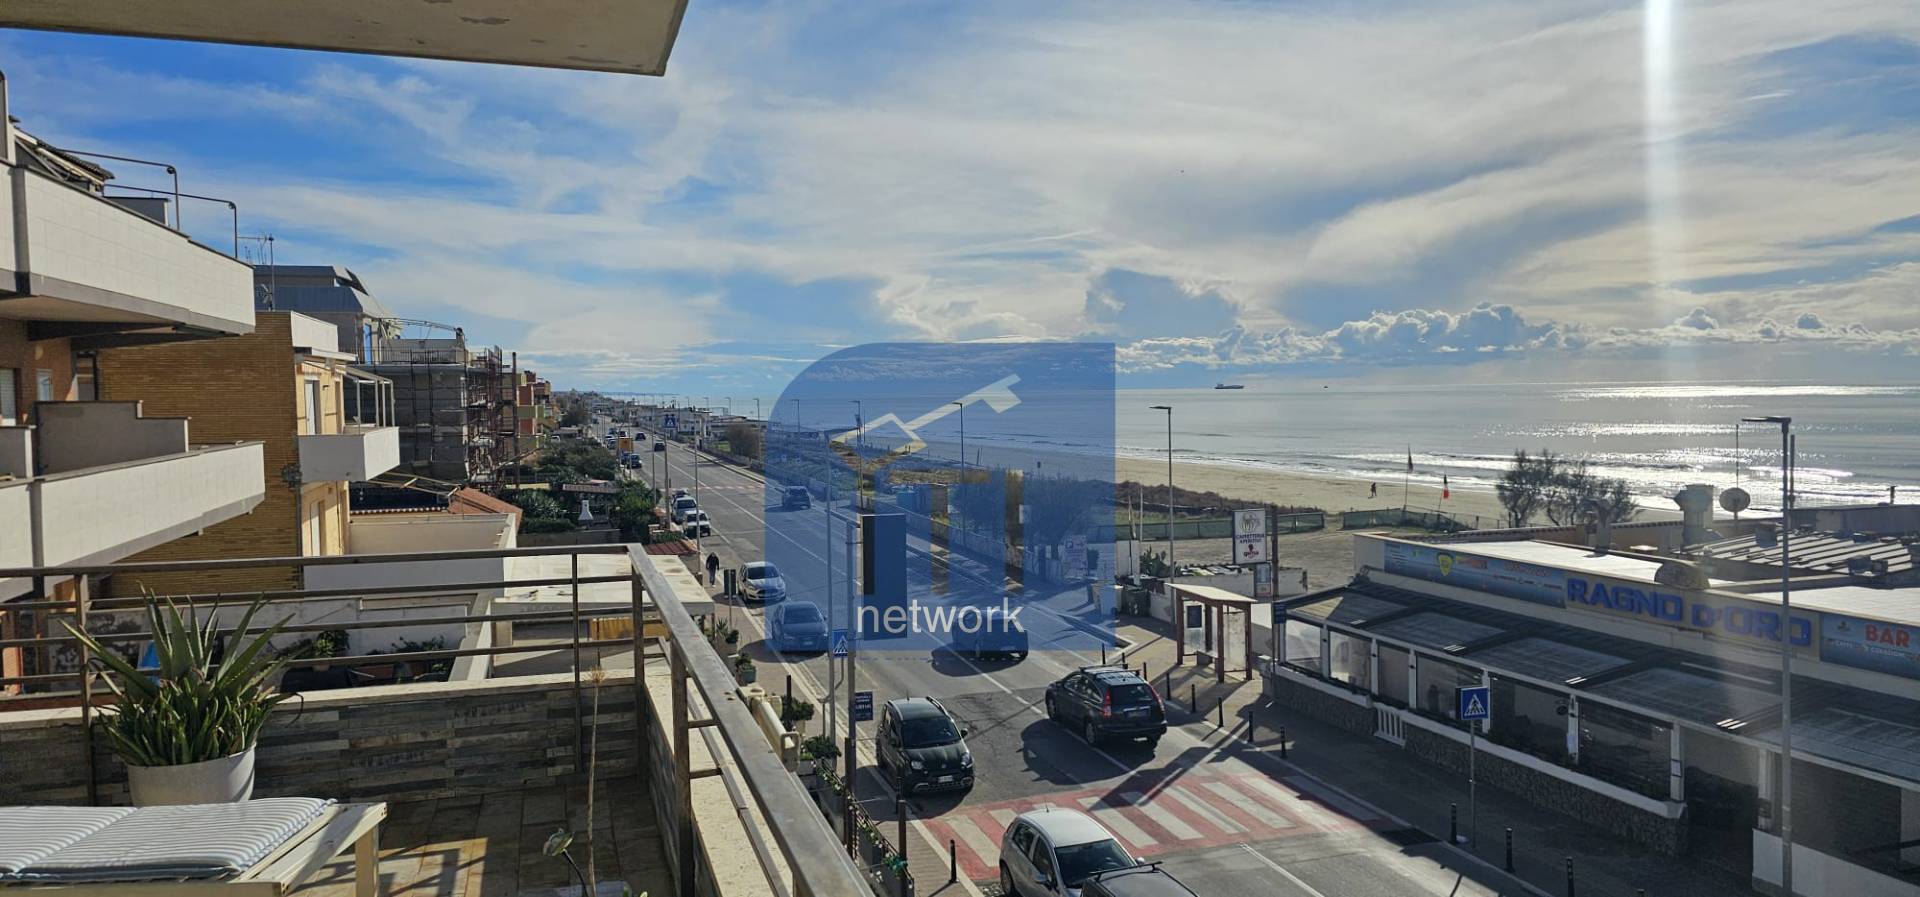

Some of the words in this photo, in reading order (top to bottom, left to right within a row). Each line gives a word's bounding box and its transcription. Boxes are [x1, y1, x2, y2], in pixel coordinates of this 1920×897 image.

[1567, 578, 1683, 621] RAGNO
[1692, 604, 1812, 646] D'ORO
[1865, 623, 1910, 648] BAR
